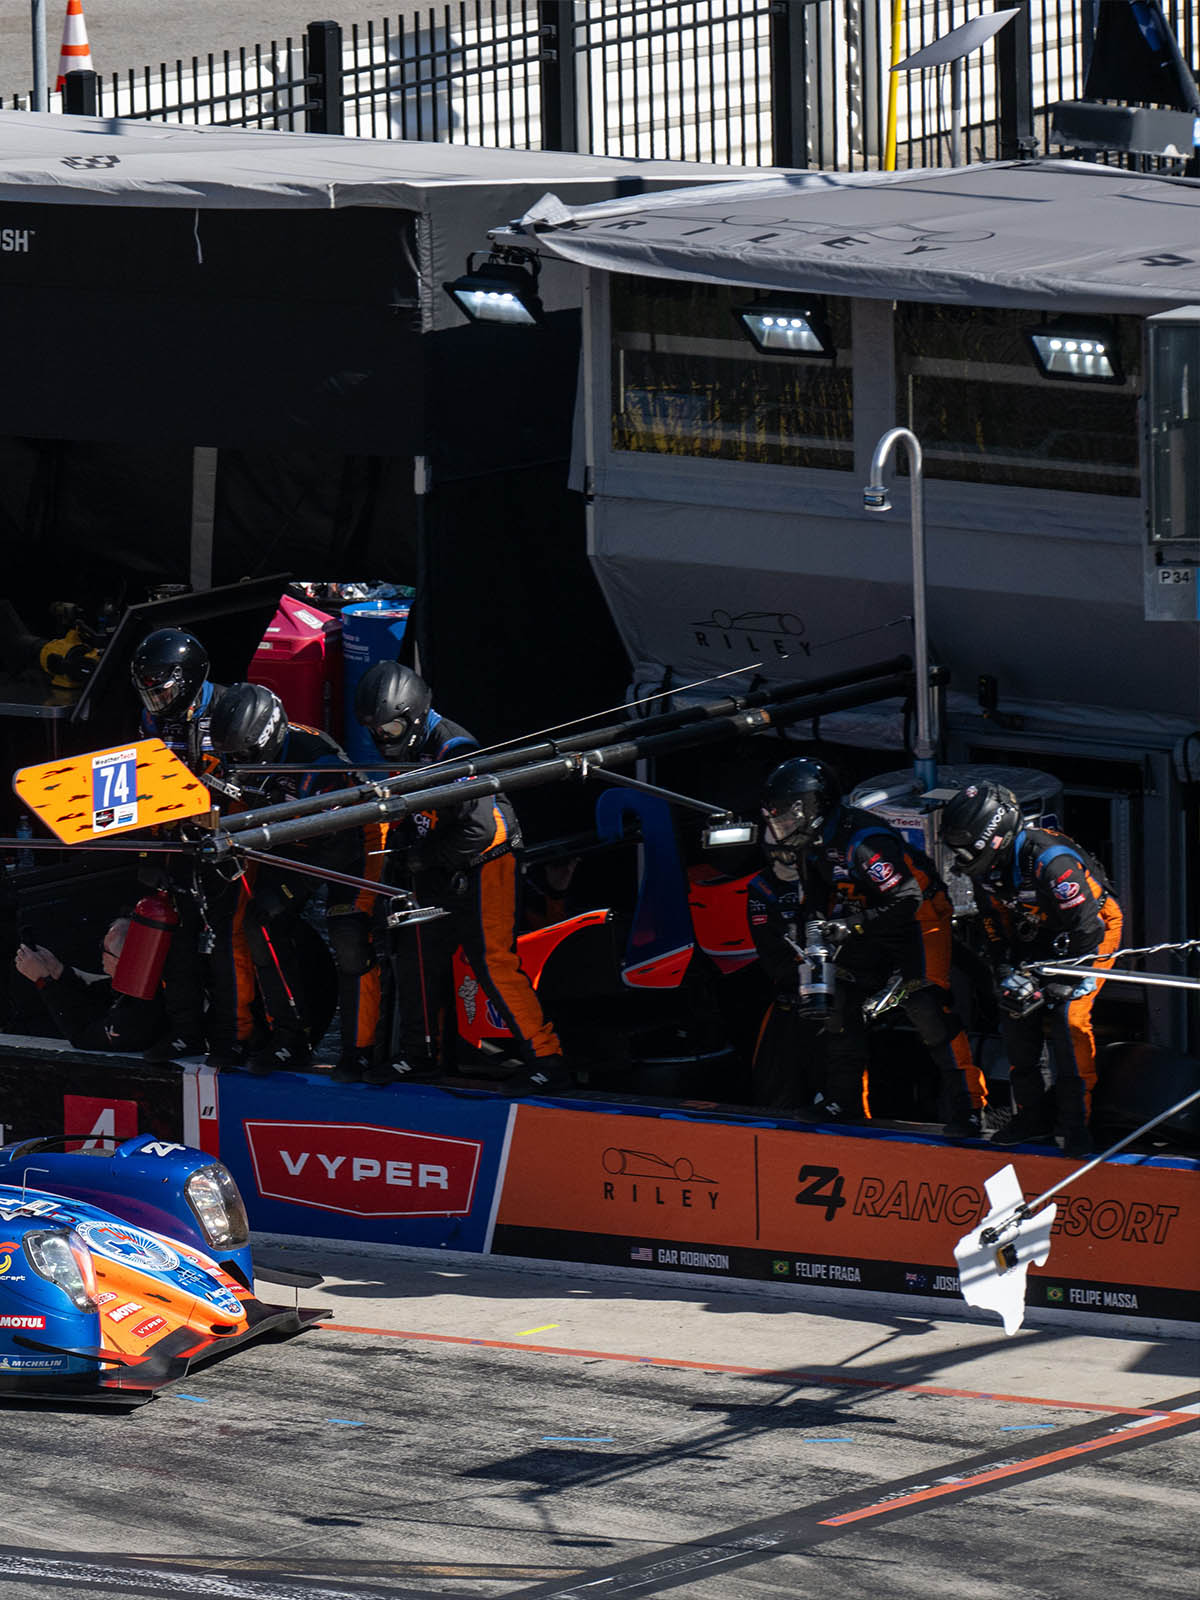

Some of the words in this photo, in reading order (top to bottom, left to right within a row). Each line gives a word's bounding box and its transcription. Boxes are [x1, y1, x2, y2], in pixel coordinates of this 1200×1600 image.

[602, 219, 946, 256] RILEY
[693, 631, 813, 657] RILEY
[100, 763, 130, 808] 74
[279, 1150, 449, 1190] VYPER
[603, 1181, 720, 1210] RILEY
[853, 1177, 990, 1225] RANC
[1043, 1188, 1180, 1246] ESORT
[657, 1248, 678, 1267] GAR
[680, 1250, 730, 1271] ROBINSON
[795, 1262, 828, 1281] FELIPE
[830, 1265, 862, 1284] FRAGA
[932, 1275, 959, 1293] JOSH
[1069, 1288, 1101, 1307] FELIPE
[1103, 1290, 1139, 1310] MASSA
[0, 1317, 44, 1328] MOTUL
[109, 1302, 144, 1322] MOTUL
[137, 1317, 164, 1335] VYPER
[10, 1359, 63, 1368] MICHELIN
